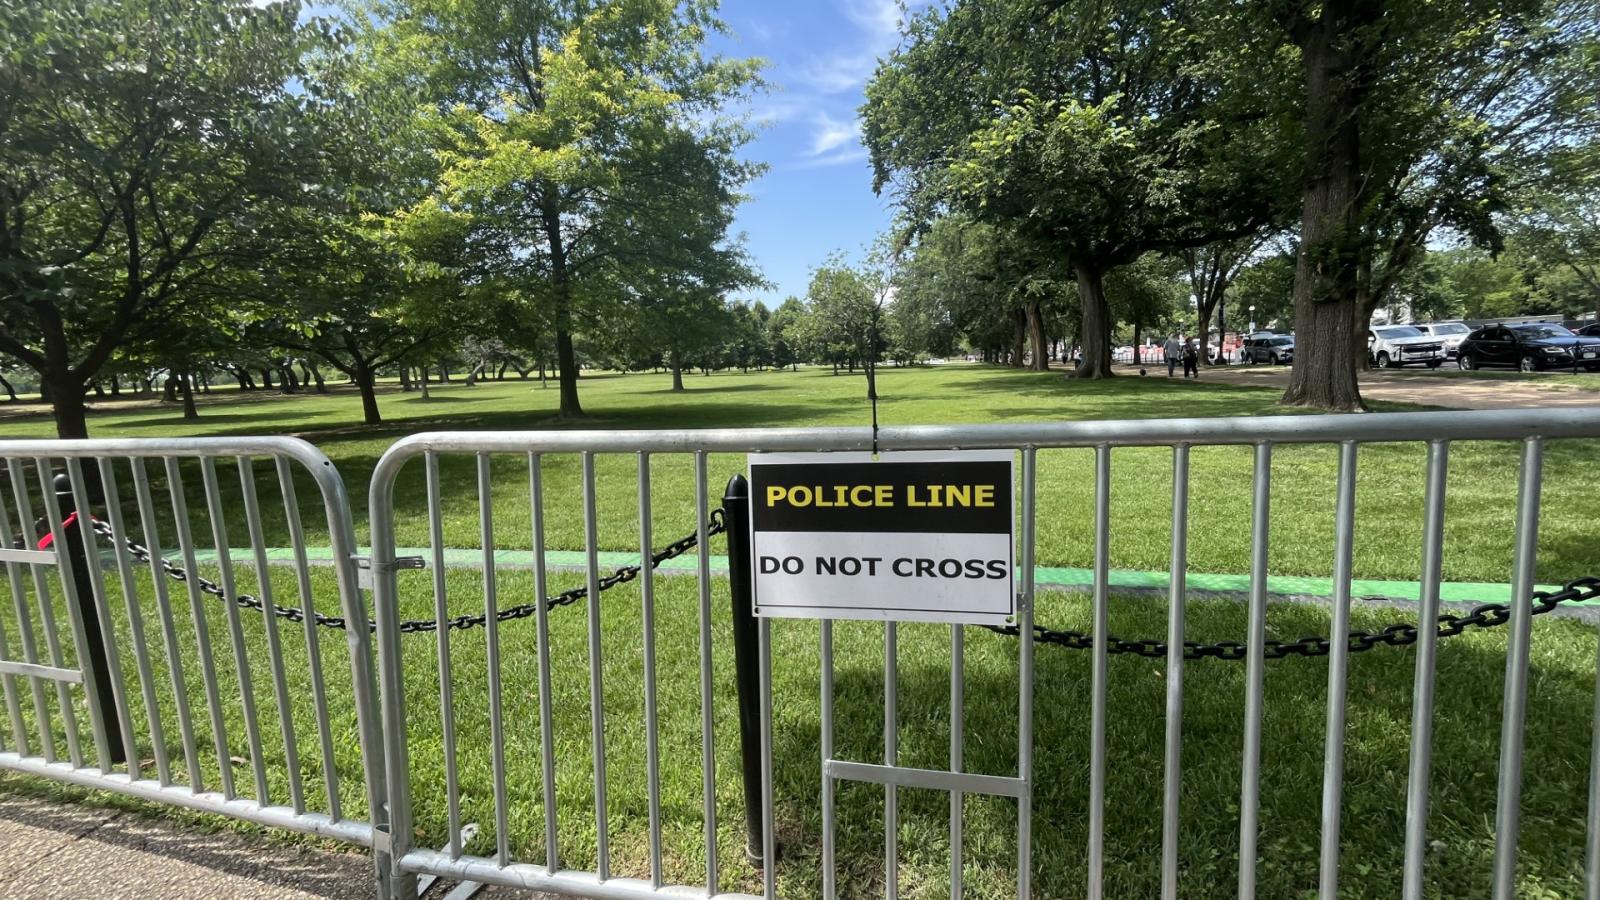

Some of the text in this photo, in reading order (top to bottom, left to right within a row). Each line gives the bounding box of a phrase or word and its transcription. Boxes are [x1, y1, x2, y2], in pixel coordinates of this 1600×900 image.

[766, 485, 995, 508] POLICE LINE
[760, 556, 1007, 580] DO NOT CROSS
